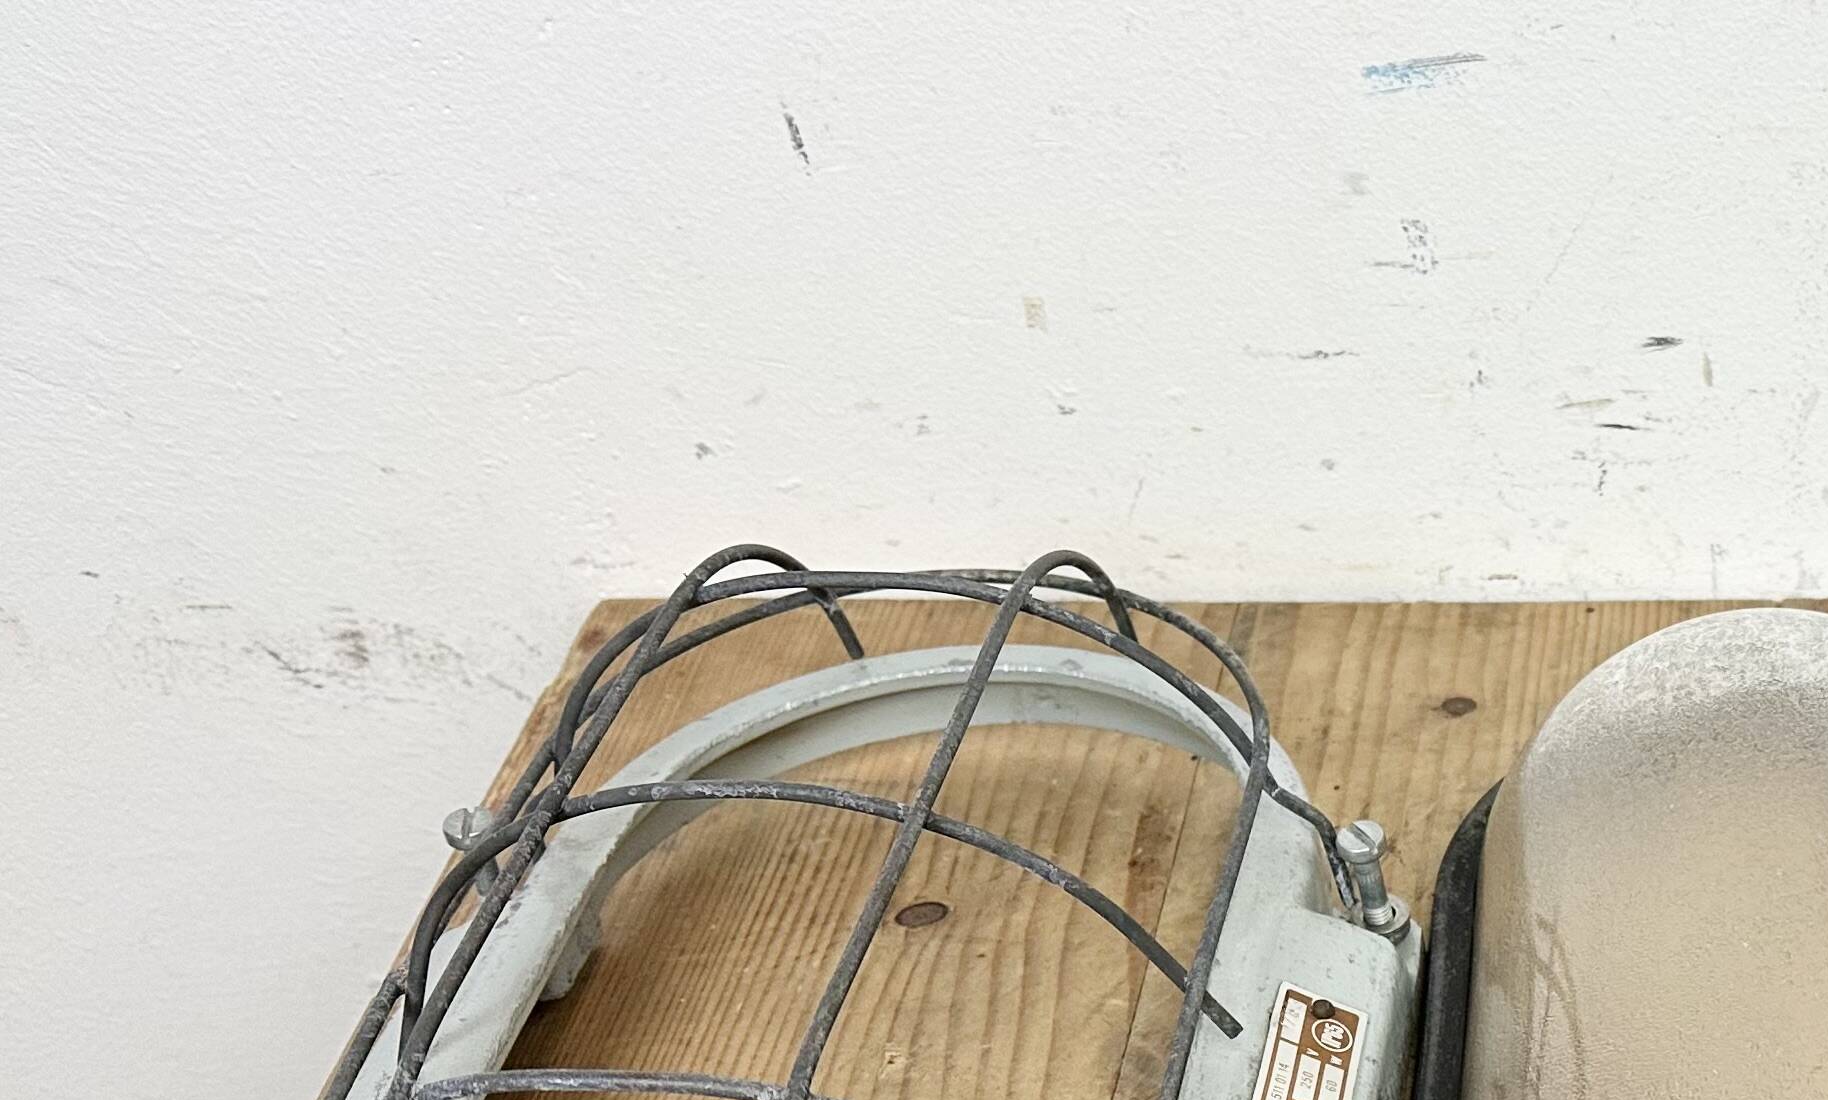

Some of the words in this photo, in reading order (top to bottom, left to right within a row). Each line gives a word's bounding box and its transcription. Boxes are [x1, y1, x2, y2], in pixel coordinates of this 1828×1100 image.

[1306, 1048, 1319, 1057] V
[1300, 1070, 1314, 1089] 250
[1325, 1079, 1338, 1092] 60
